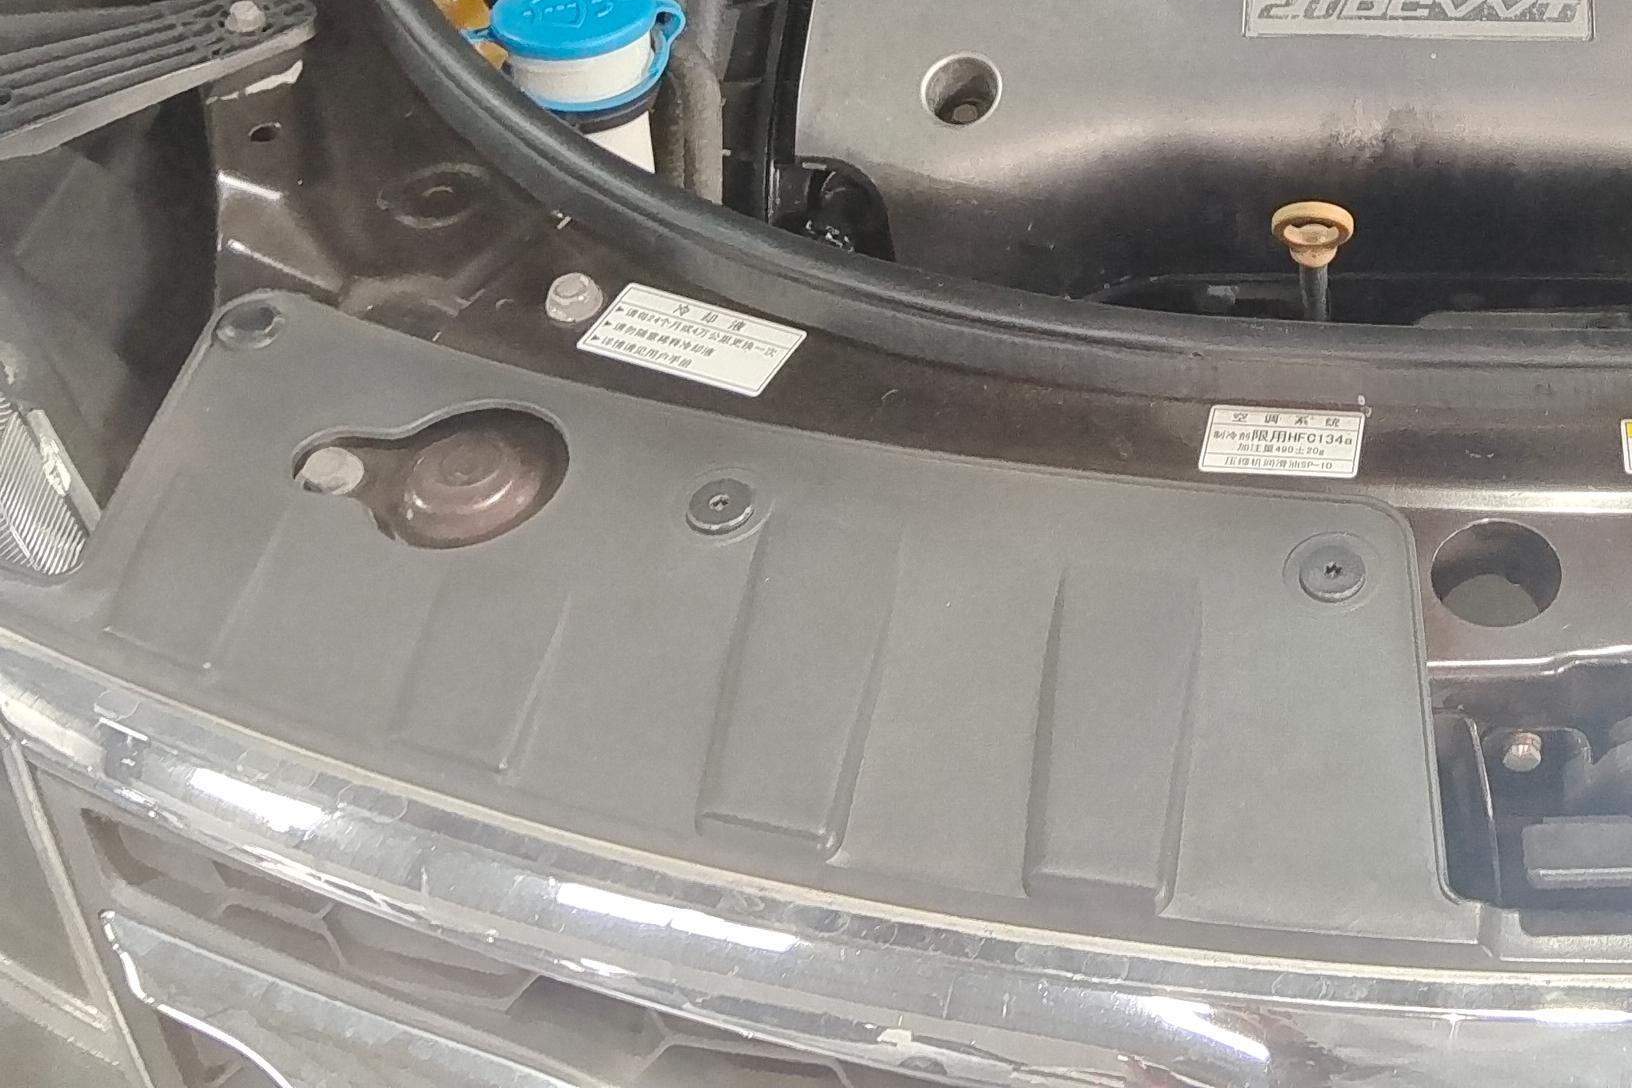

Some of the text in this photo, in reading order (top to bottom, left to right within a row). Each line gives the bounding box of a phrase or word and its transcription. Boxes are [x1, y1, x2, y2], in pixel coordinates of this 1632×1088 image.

[672, 303, 747, 333] 冷却液
[1231, 412, 1340, 427] 空调系统
